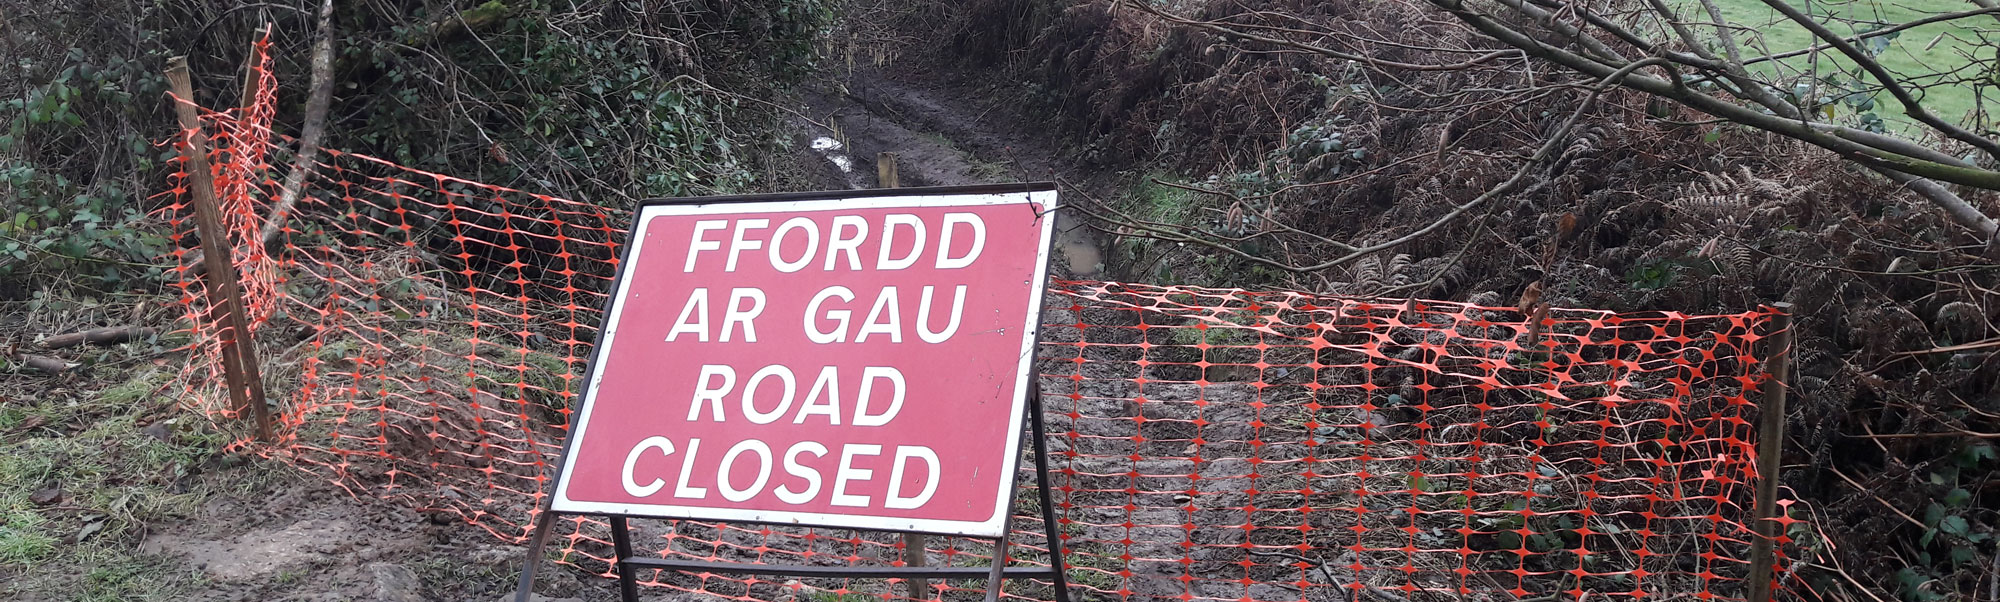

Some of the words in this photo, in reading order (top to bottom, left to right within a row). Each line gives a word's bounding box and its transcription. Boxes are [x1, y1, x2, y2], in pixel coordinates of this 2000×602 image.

[683, 212, 987, 273] FFORDD
[664, 287, 767, 343] AR
[803, 284, 968, 344] GAU
[686, 364, 906, 427] ROAD
[621, 435, 941, 510] CLOSED
